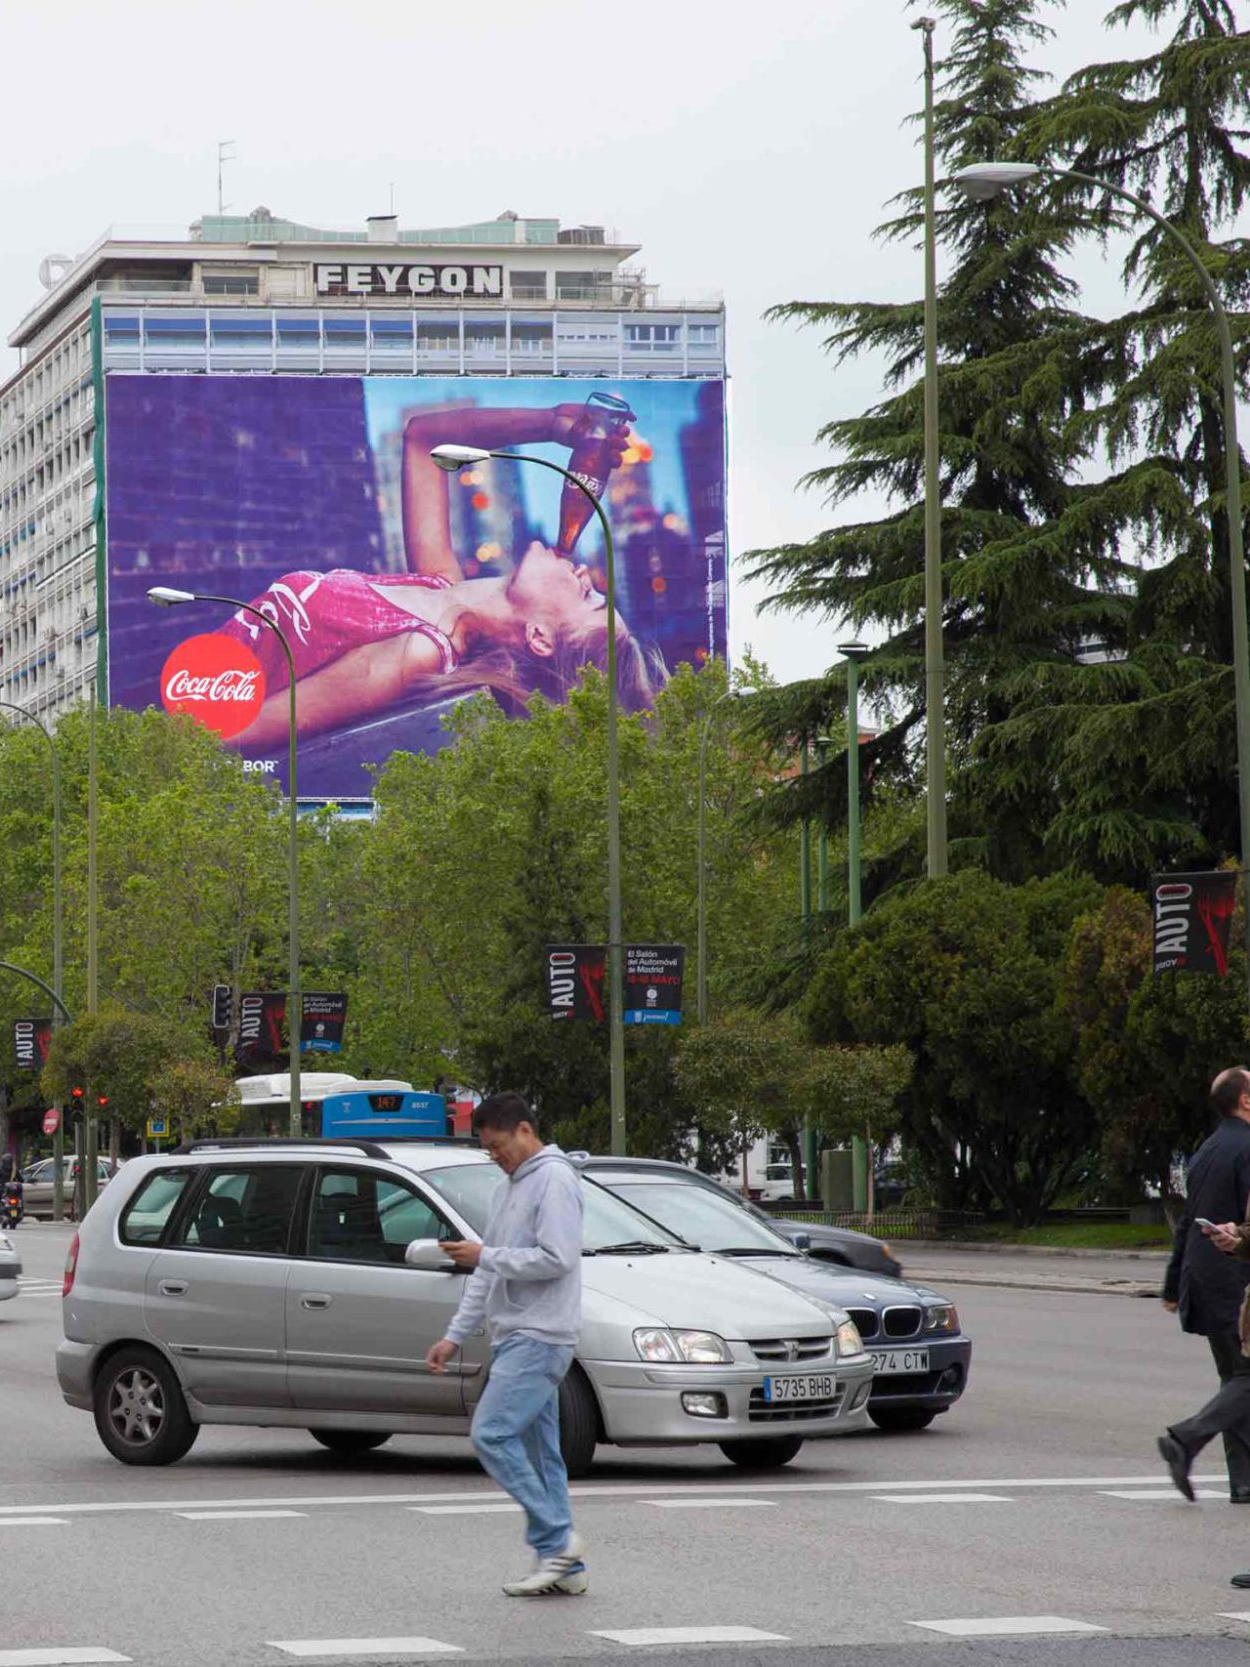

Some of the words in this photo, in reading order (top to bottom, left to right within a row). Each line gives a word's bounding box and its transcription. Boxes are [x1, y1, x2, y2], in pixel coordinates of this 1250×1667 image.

[317, 265, 500, 293] FEYGON
[166, 670, 260, 701] Coca-Cola
[242, 760, 274, 773] BOR
[1155, 883, 1193, 954] AUTO
[550, 952, 576, 1006] AUTO
[241, 997, 263, 1037] AUTO
[15, 1022, 34, 1059] AUTO
[871, 1353, 896, 1371] 274
[903, 1352, 928, 1369] CTW
[774, 1378, 806, 1399] 5735
[809, 1377, 832, 1397] BHB
